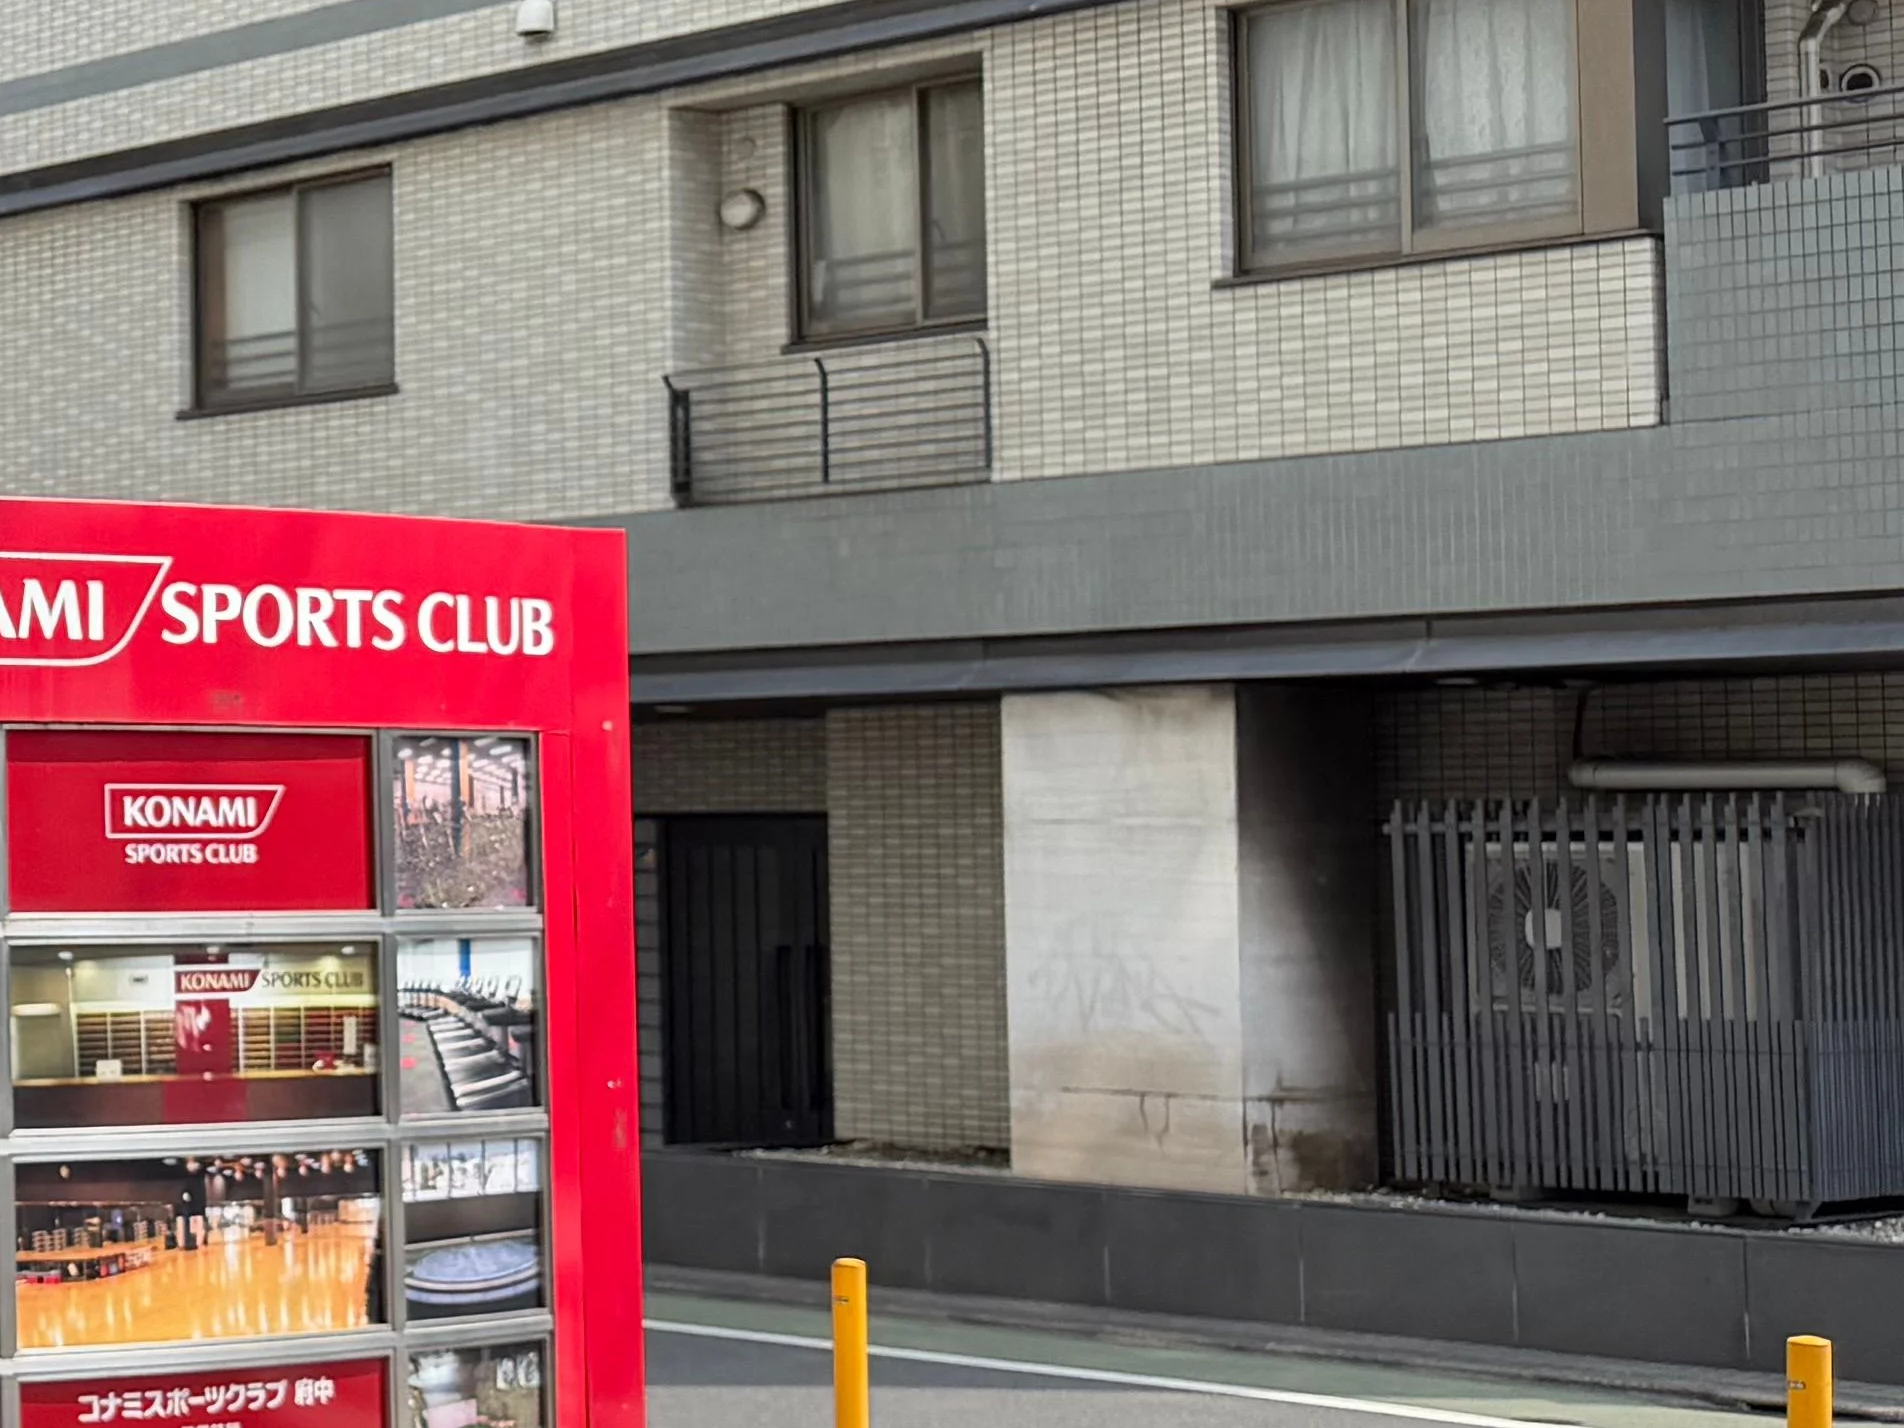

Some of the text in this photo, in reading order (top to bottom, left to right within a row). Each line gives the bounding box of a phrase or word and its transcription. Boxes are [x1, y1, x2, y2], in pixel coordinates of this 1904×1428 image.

[161, 580, 405, 652] SPORTS
[418, 591, 554, 657] CLUB
[123, 795, 259, 828] KONAMI
[125, 843, 260, 865] SPORTS CLUB
[180, 972, 365, 990] KONAMI SPORTS CLUB
[78, 1376, 336, 1423] コナミスポーツクラブ 府中
